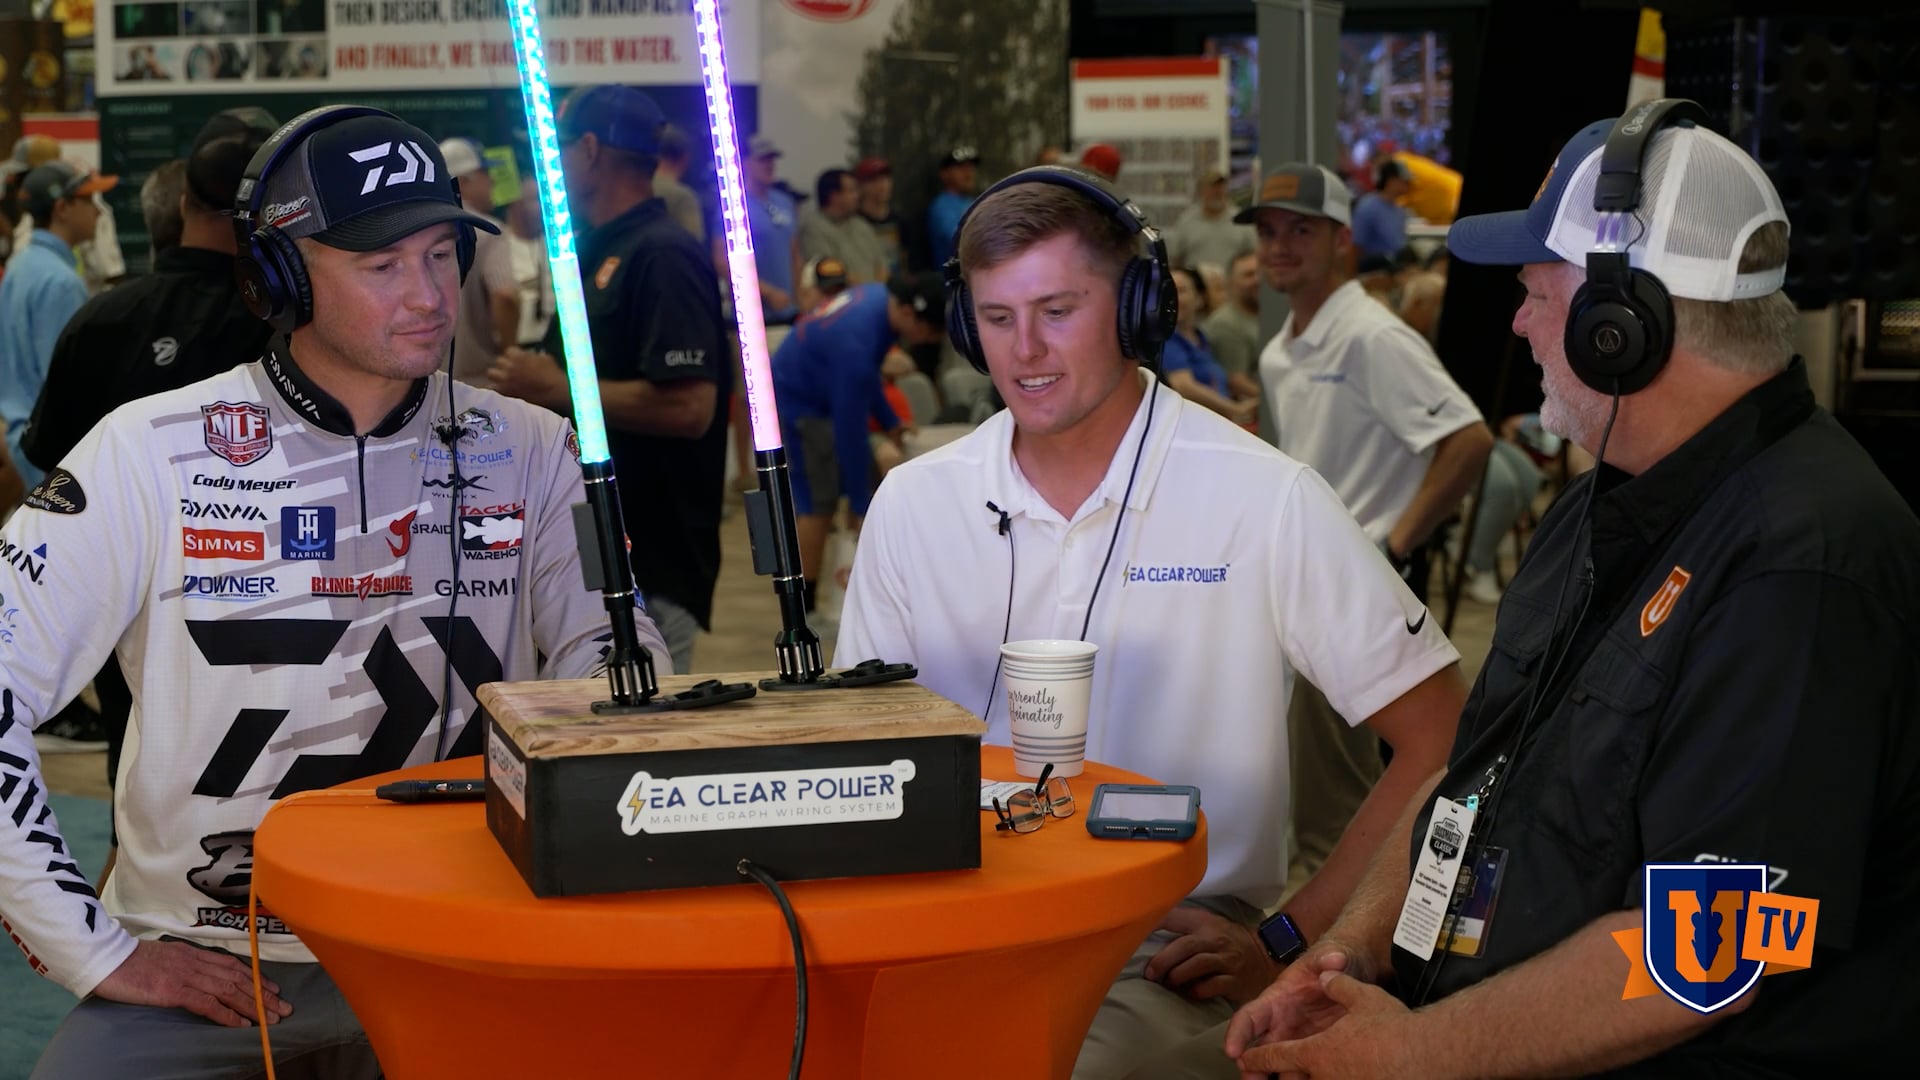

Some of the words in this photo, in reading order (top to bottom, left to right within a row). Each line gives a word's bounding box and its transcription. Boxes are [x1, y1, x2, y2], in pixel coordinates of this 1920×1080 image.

[335, 44, 367, 69] AND
[373, 42, 444, 71] FINALLY,
[449, 41, 473, 68] WE
[575, 37, 605, 64] THE
[611, 36, 681, 63] WATER.
[210, 412, 263, 443] MLF
[470, 448, 513, 464] POWER
[192, 474, 235, 491] Cody
[237, 479, 297, 492] Meyer
[184, 533, 257, 553] SIMMS
[289, 551, 327, 559] MARINE
[311, 576, 354, 593] BLING
[1148, 567, 1185, 582] CLEAR
[1186, 567, 1227, 583] POWER
[434, 577, 516, 598] GARMI
[698, 779, 788, 807] CLEAR
[798, 773, 895, 801] POWER
[650, 812, 709, 825] MARINE
[716, 808, 769, 822] GRAPH
[776, 804, 832, 818] WIRING
[839, 801, 897, 815] SYSTEM
